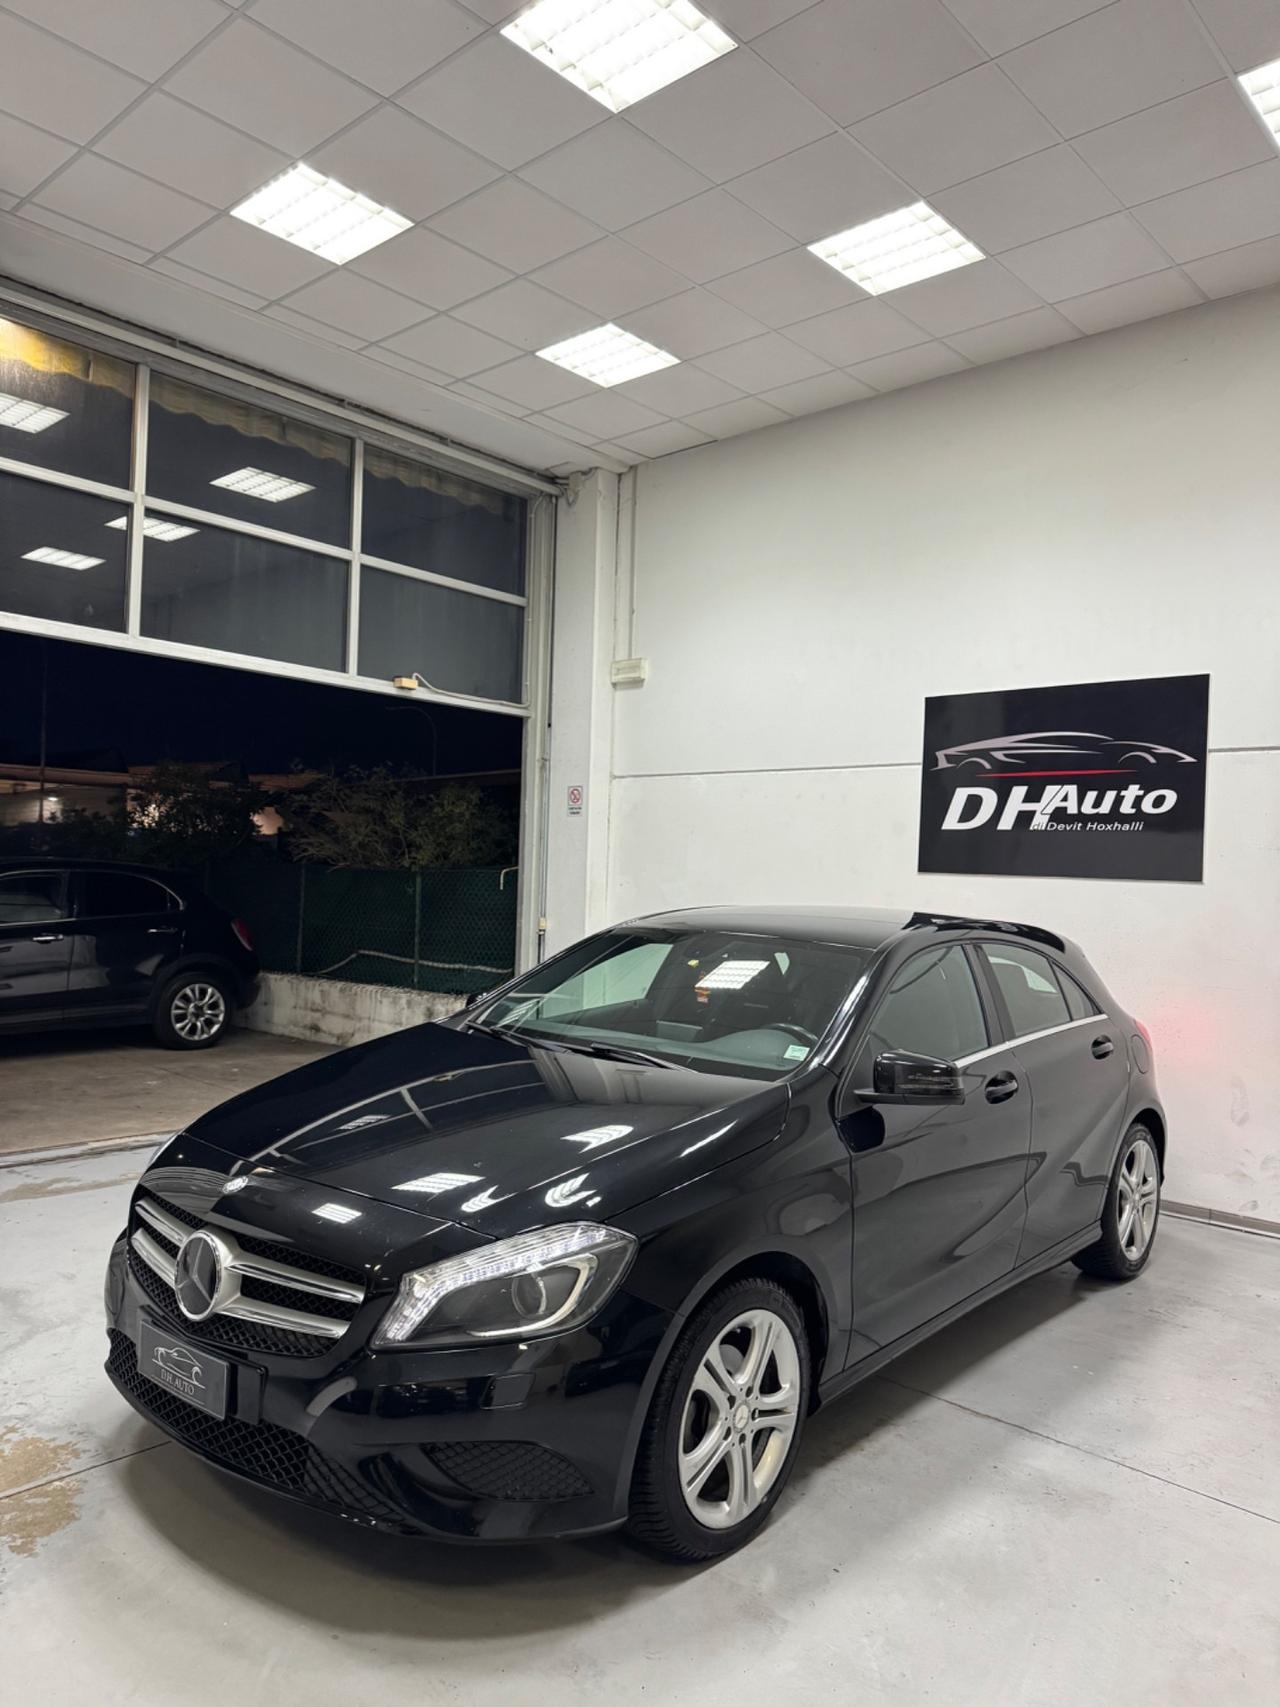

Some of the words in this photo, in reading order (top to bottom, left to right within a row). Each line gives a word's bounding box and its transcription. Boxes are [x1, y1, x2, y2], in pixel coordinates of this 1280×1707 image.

[1047, 821, 1082, 831] Devit
[1086, 821, 1144, 831] Hoxhalli
[174, 1377, 194, 1395] AUTO
